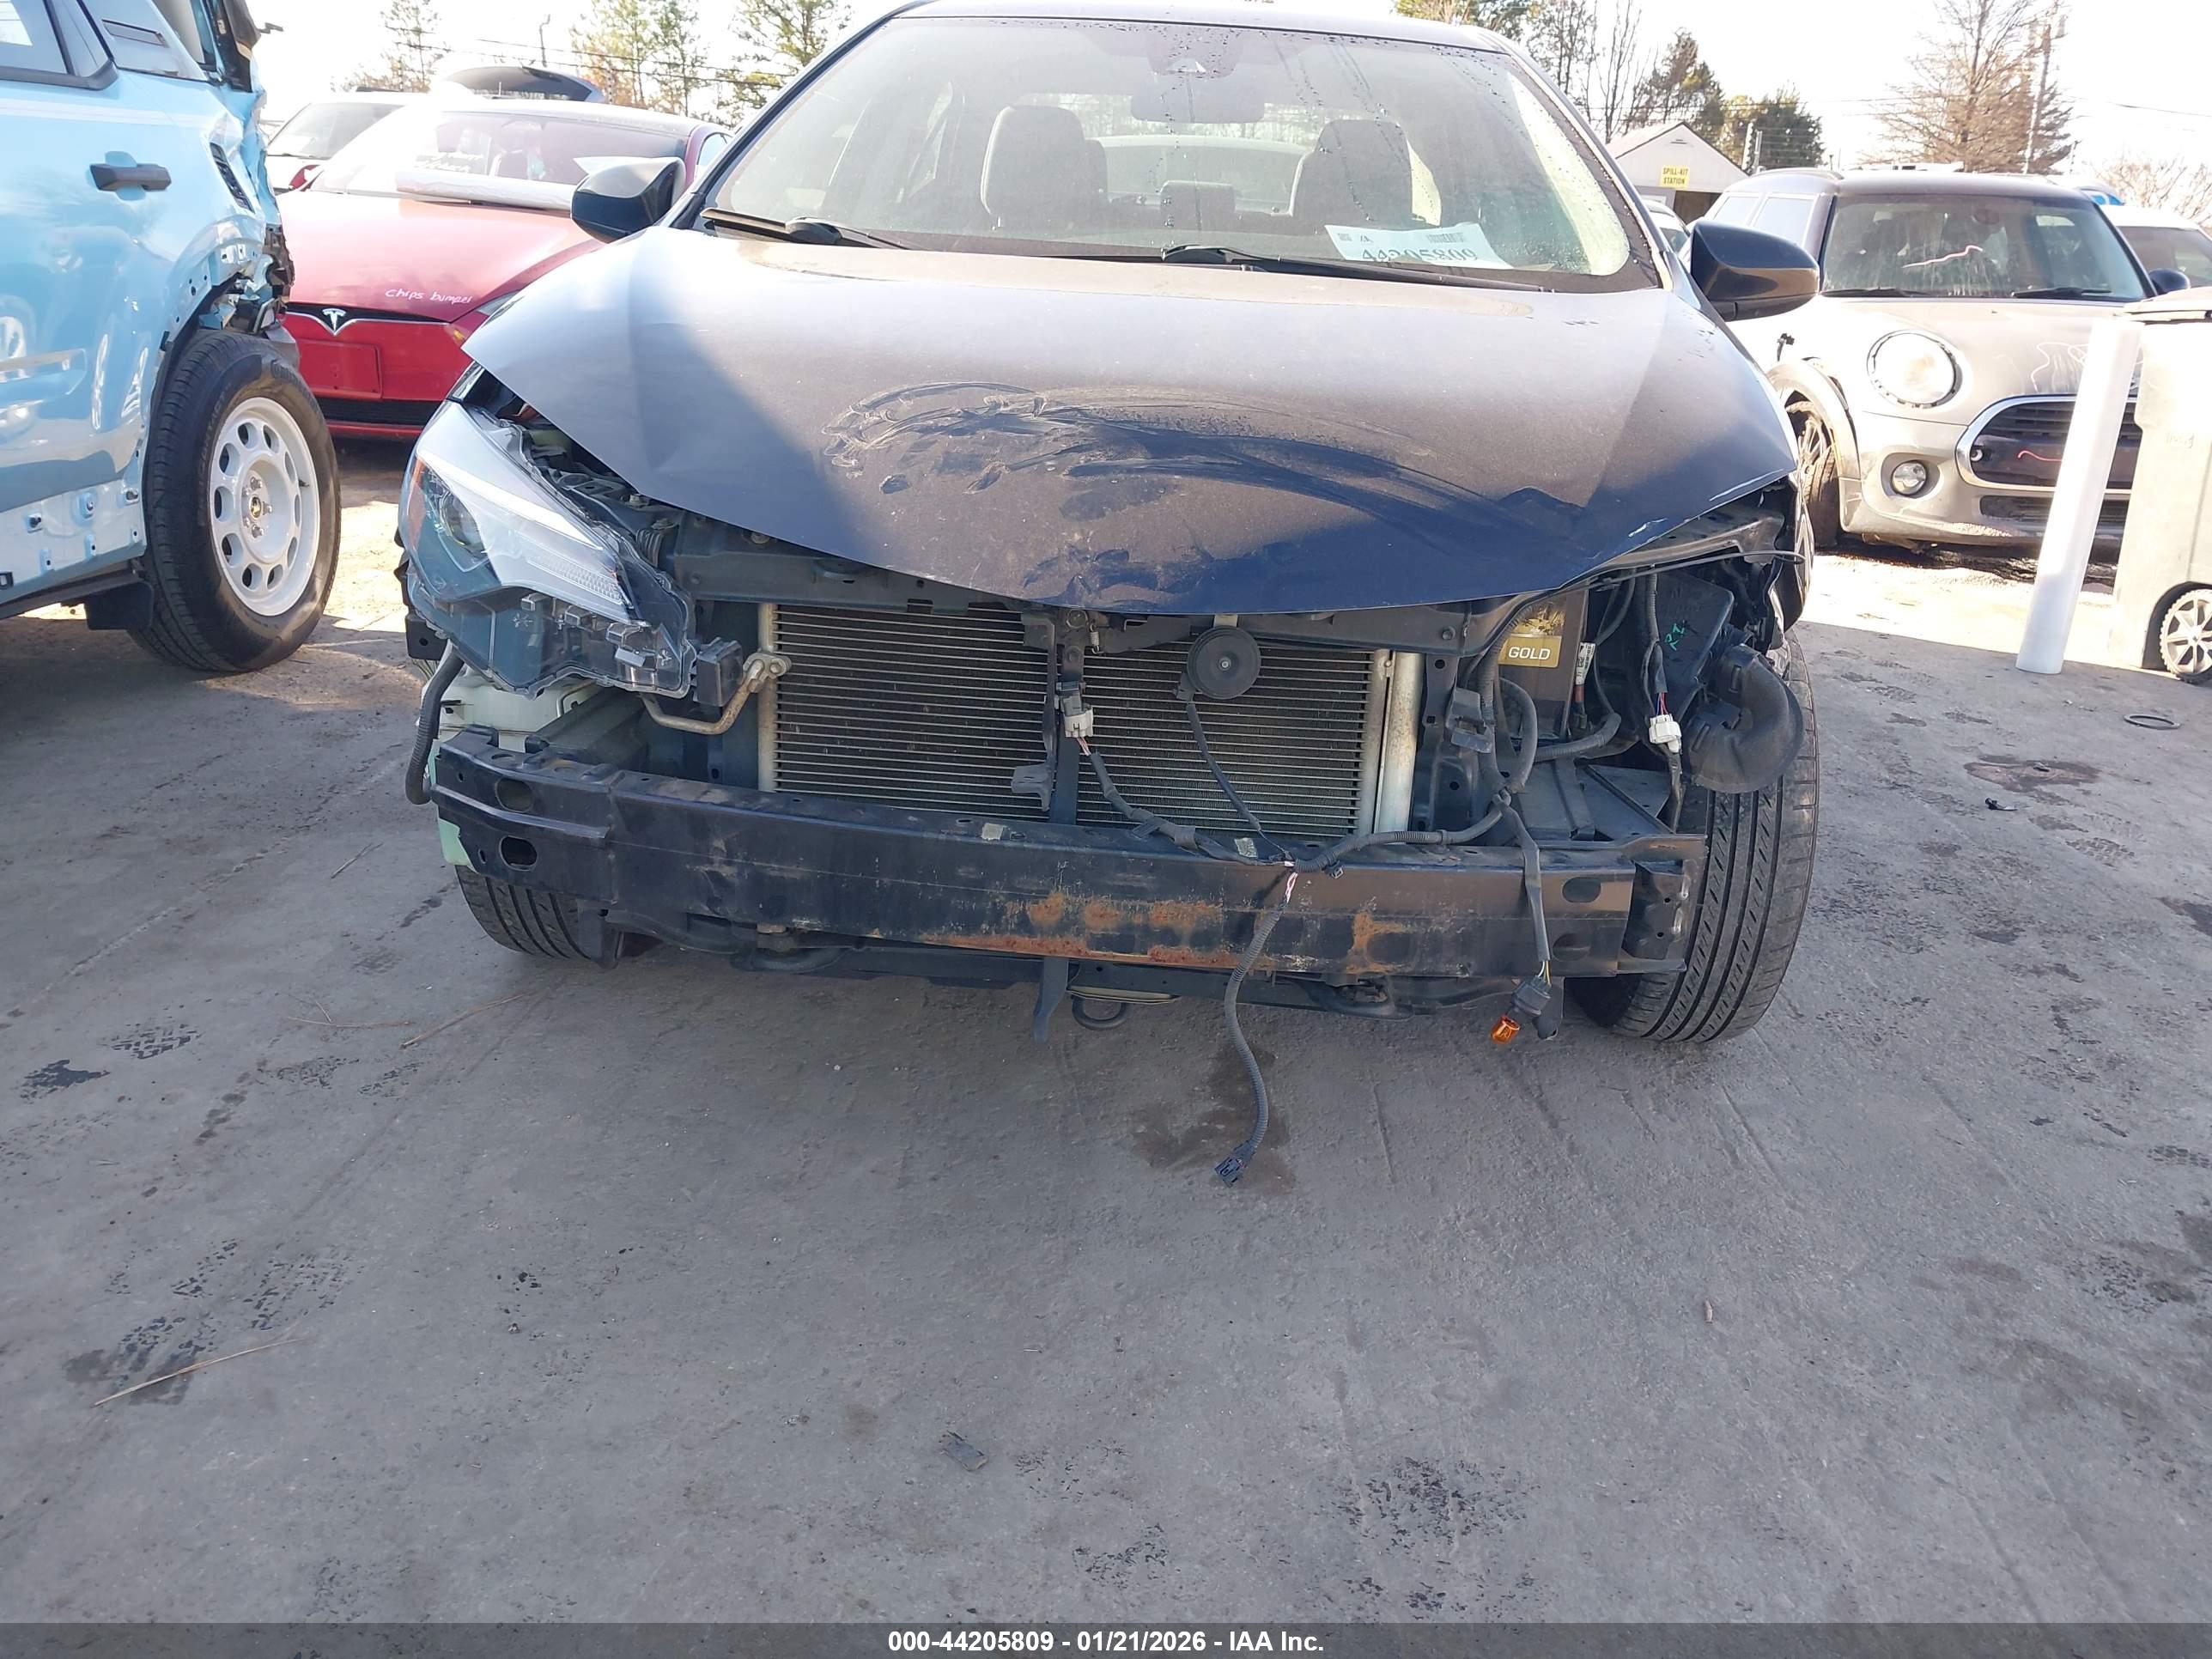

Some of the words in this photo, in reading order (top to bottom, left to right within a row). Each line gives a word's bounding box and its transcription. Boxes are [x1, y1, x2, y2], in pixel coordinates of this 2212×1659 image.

[1662, 167, 1689, 176] SPILL-KIT
[1662, 177, 1686, 185] STATION
[1508, 646, 1551, 660] GOLD
